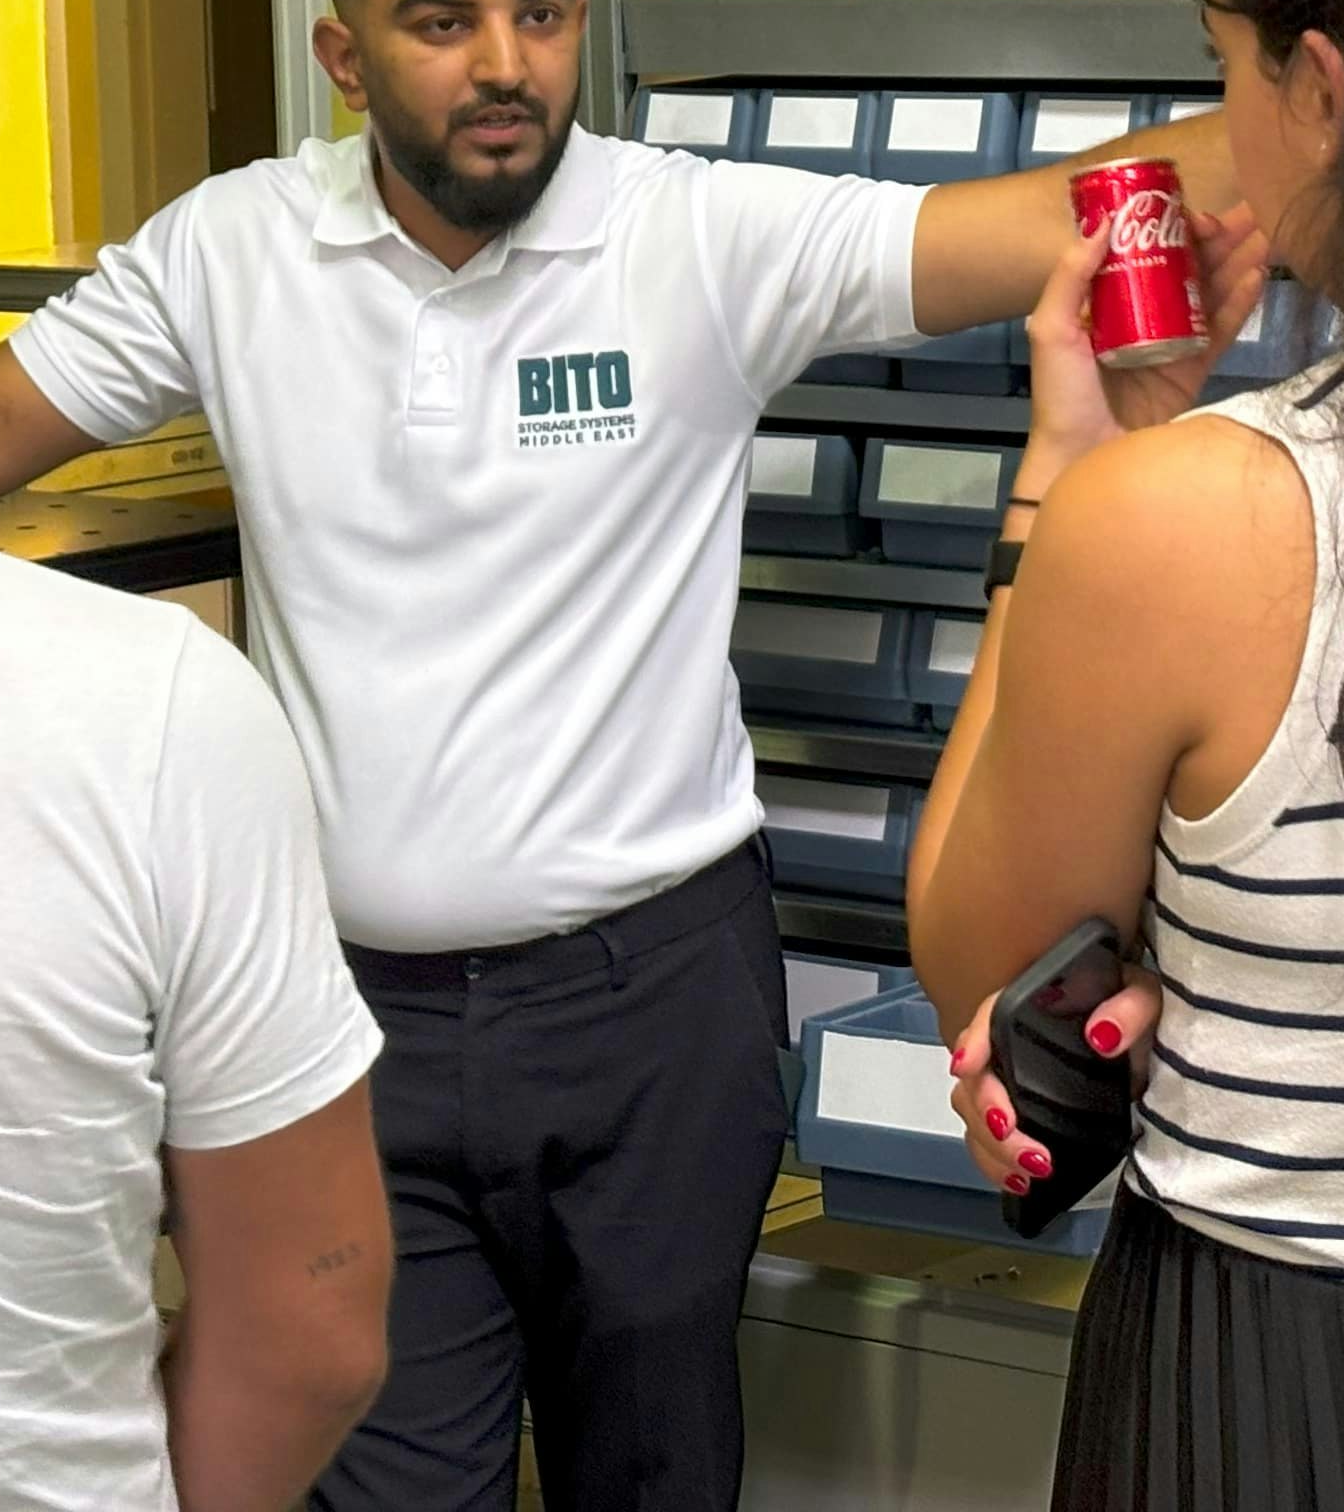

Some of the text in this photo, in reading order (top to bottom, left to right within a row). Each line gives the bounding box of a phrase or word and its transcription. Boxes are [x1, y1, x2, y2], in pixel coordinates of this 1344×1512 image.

[516, 349, 633, 417] BITO
[517, 414, 636, 434] STORAGE SYSTEMS
[519, 427, 636, 448] MIDDLE EAST
